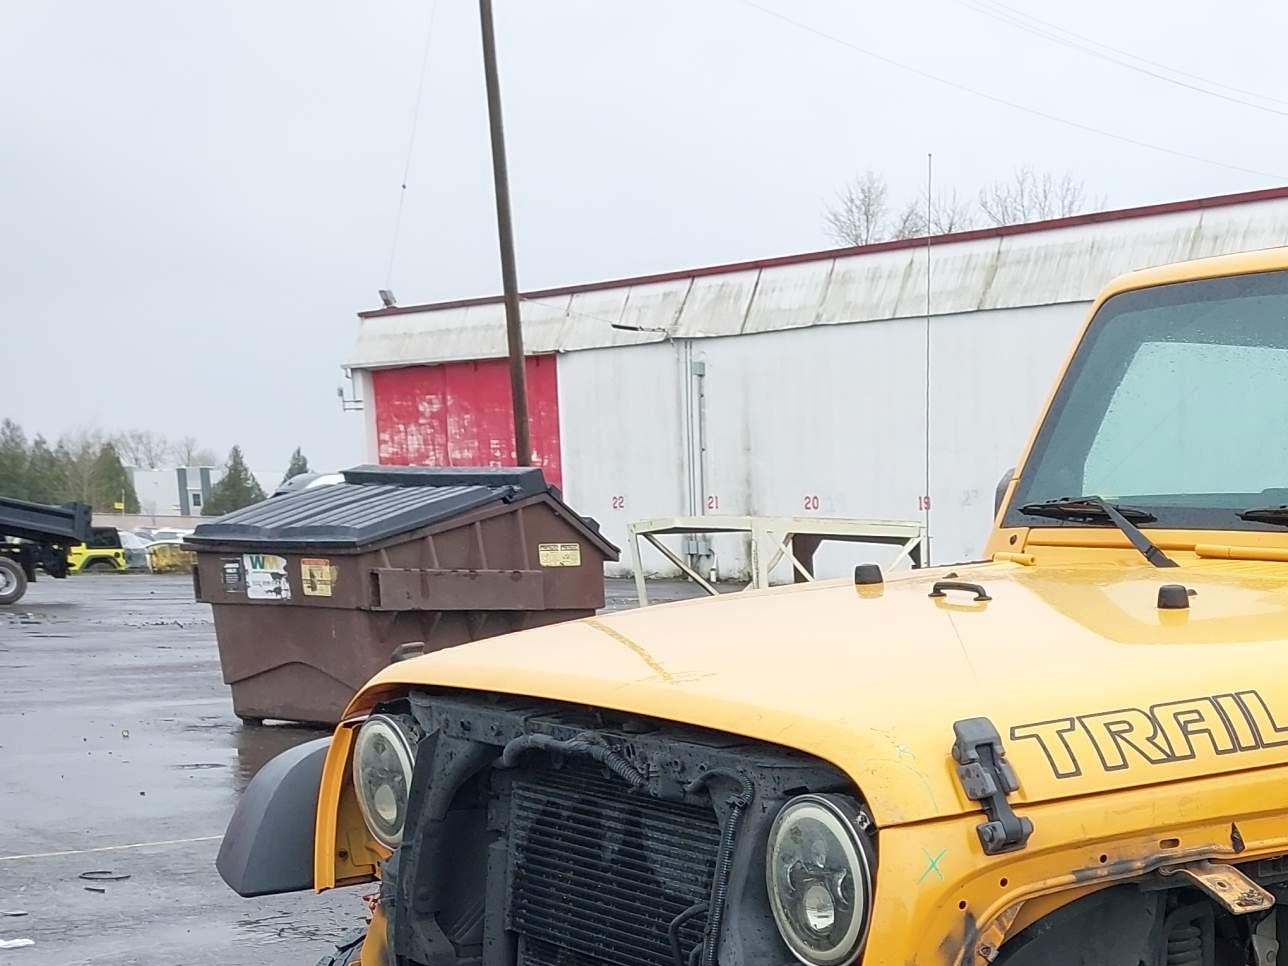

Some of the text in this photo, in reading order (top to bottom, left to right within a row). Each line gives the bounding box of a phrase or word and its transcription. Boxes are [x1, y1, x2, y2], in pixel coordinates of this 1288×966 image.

[612, 496, 625, 509] 22
[708, 496, 720, 509] 21
[804, 495, 820, 510] 20
[918, 496, 931, 510] 19
